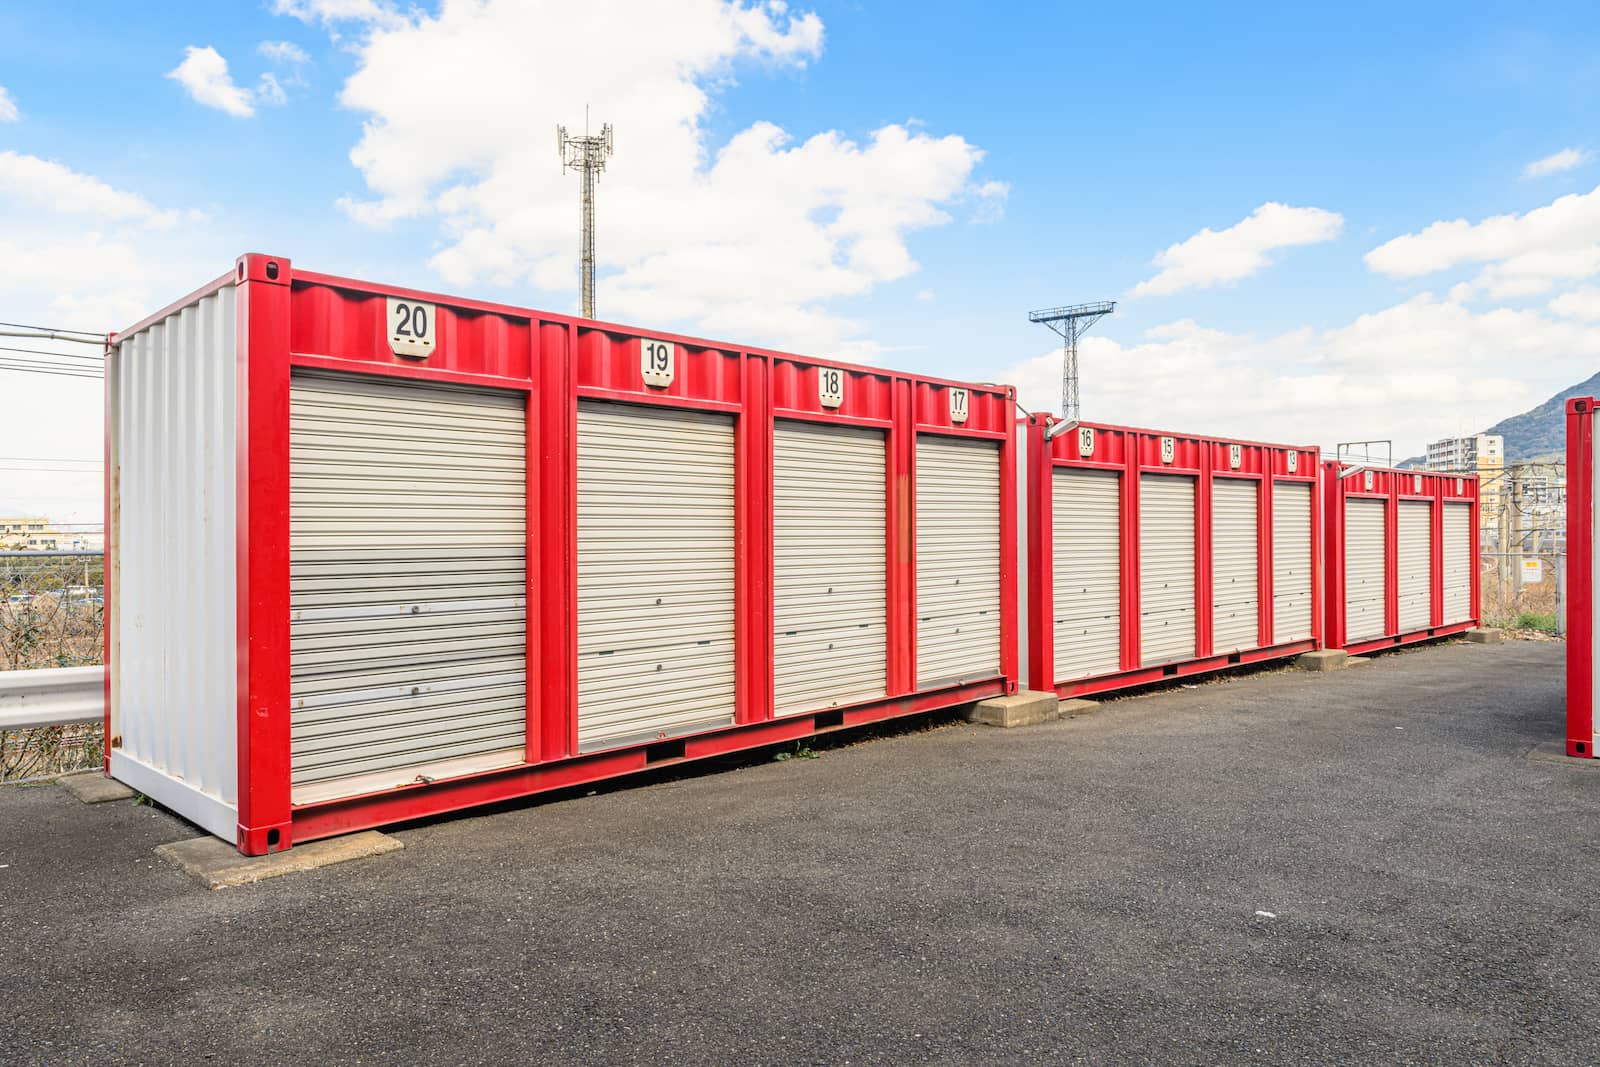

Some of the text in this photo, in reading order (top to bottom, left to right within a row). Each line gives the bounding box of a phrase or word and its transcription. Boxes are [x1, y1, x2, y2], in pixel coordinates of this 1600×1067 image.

[396, 304, 427, 337] 20
[647, 343, 669, 371] 19
[823, 372, 839, 394] 18
[953, 392, 965, 410] 17
[1081, 429, 1091, 447] 16
[1163, 439, 1172, 454] 15
[1232, 447, 1239, 460] 14
[1289, 452, 1296, 465] 13
